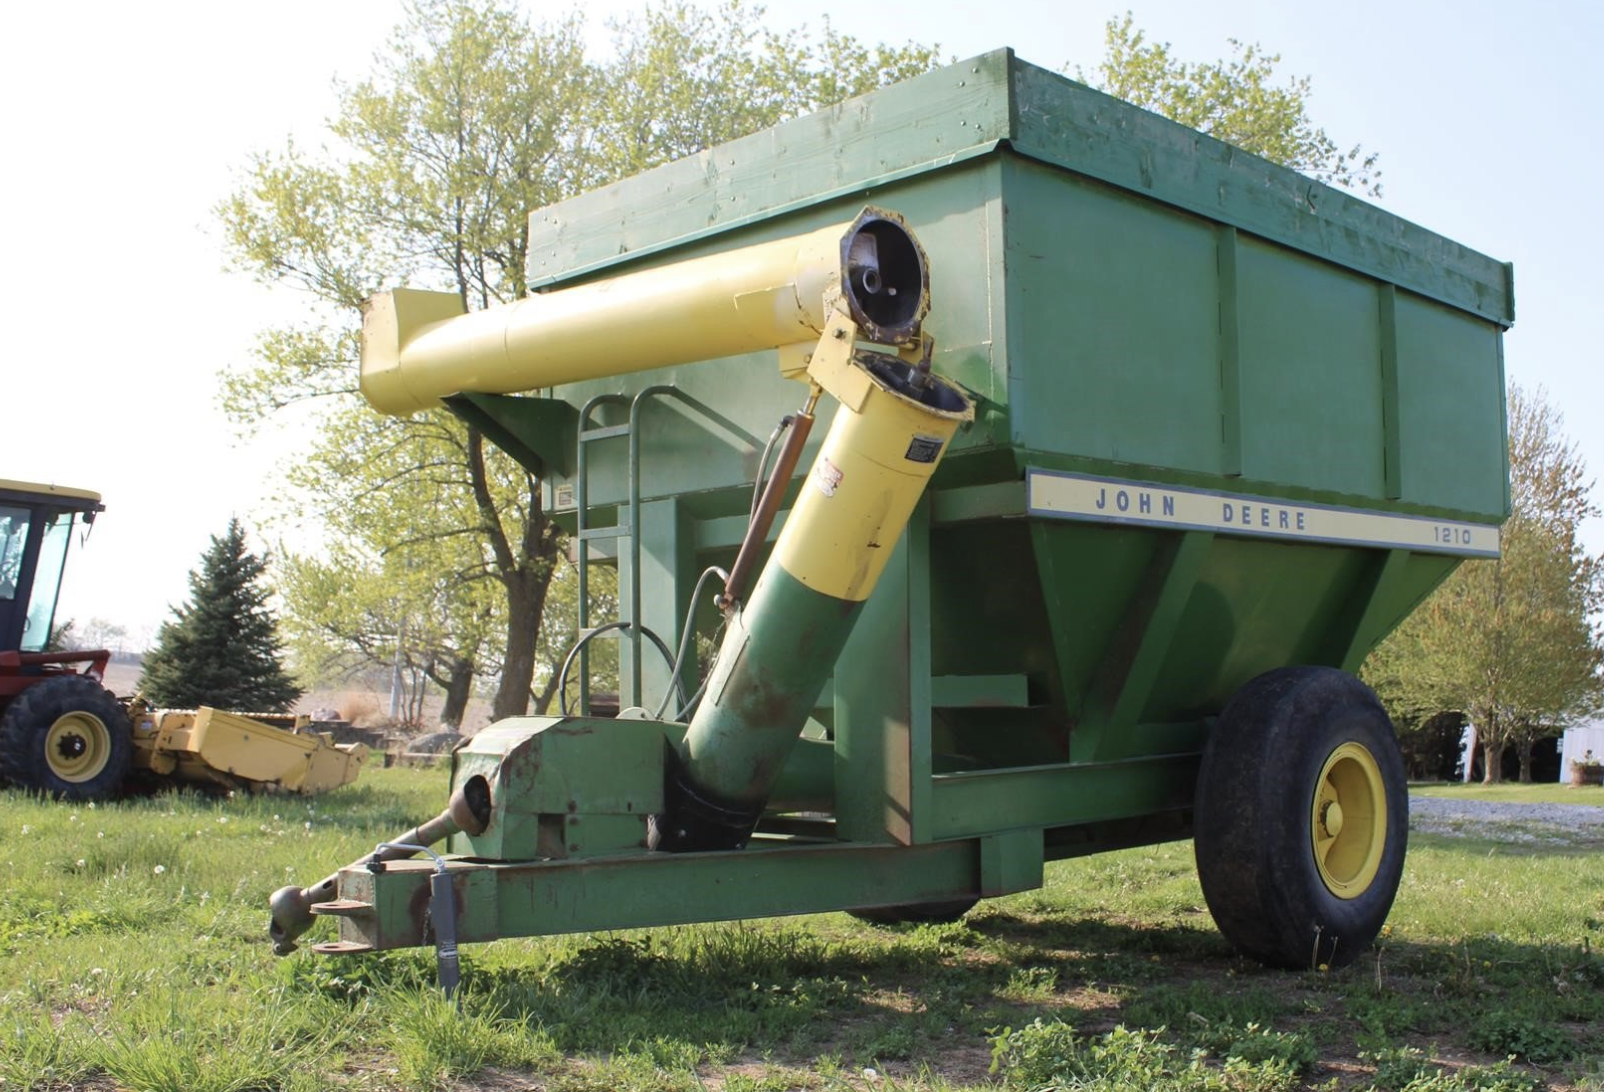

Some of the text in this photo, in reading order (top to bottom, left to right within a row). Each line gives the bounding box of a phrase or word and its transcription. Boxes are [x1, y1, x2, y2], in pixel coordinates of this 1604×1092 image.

[1096, 488, 1470, 544] JOHN DEERE 1210
